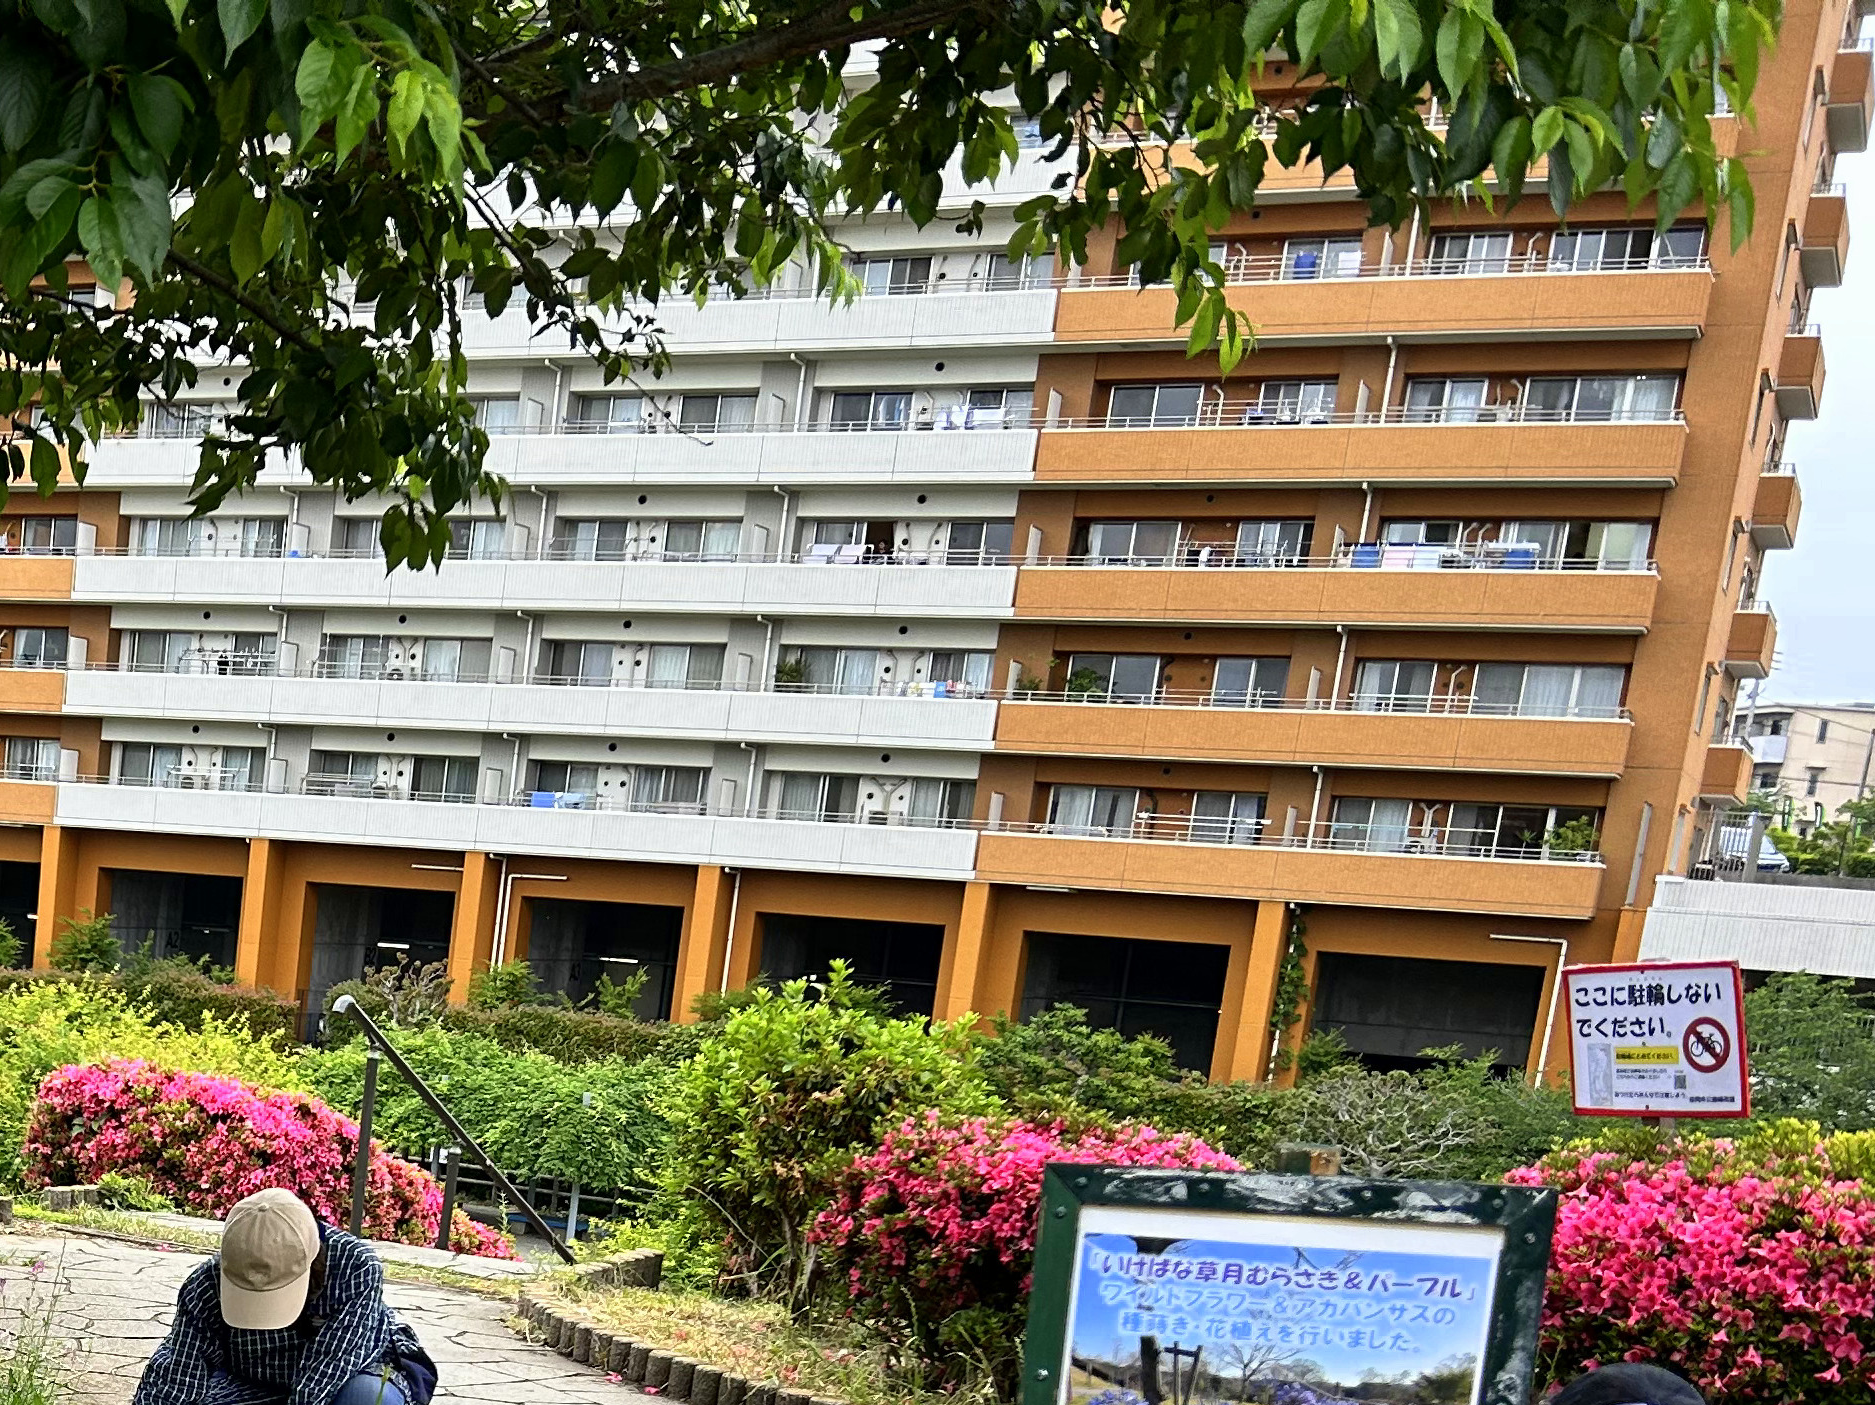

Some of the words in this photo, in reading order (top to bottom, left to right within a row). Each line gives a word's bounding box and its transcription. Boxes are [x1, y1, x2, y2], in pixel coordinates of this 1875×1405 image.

[1574, 982, 1722, 1007] ここに駐輪しない
[1576, 1016, 1672, 1038] でください。
